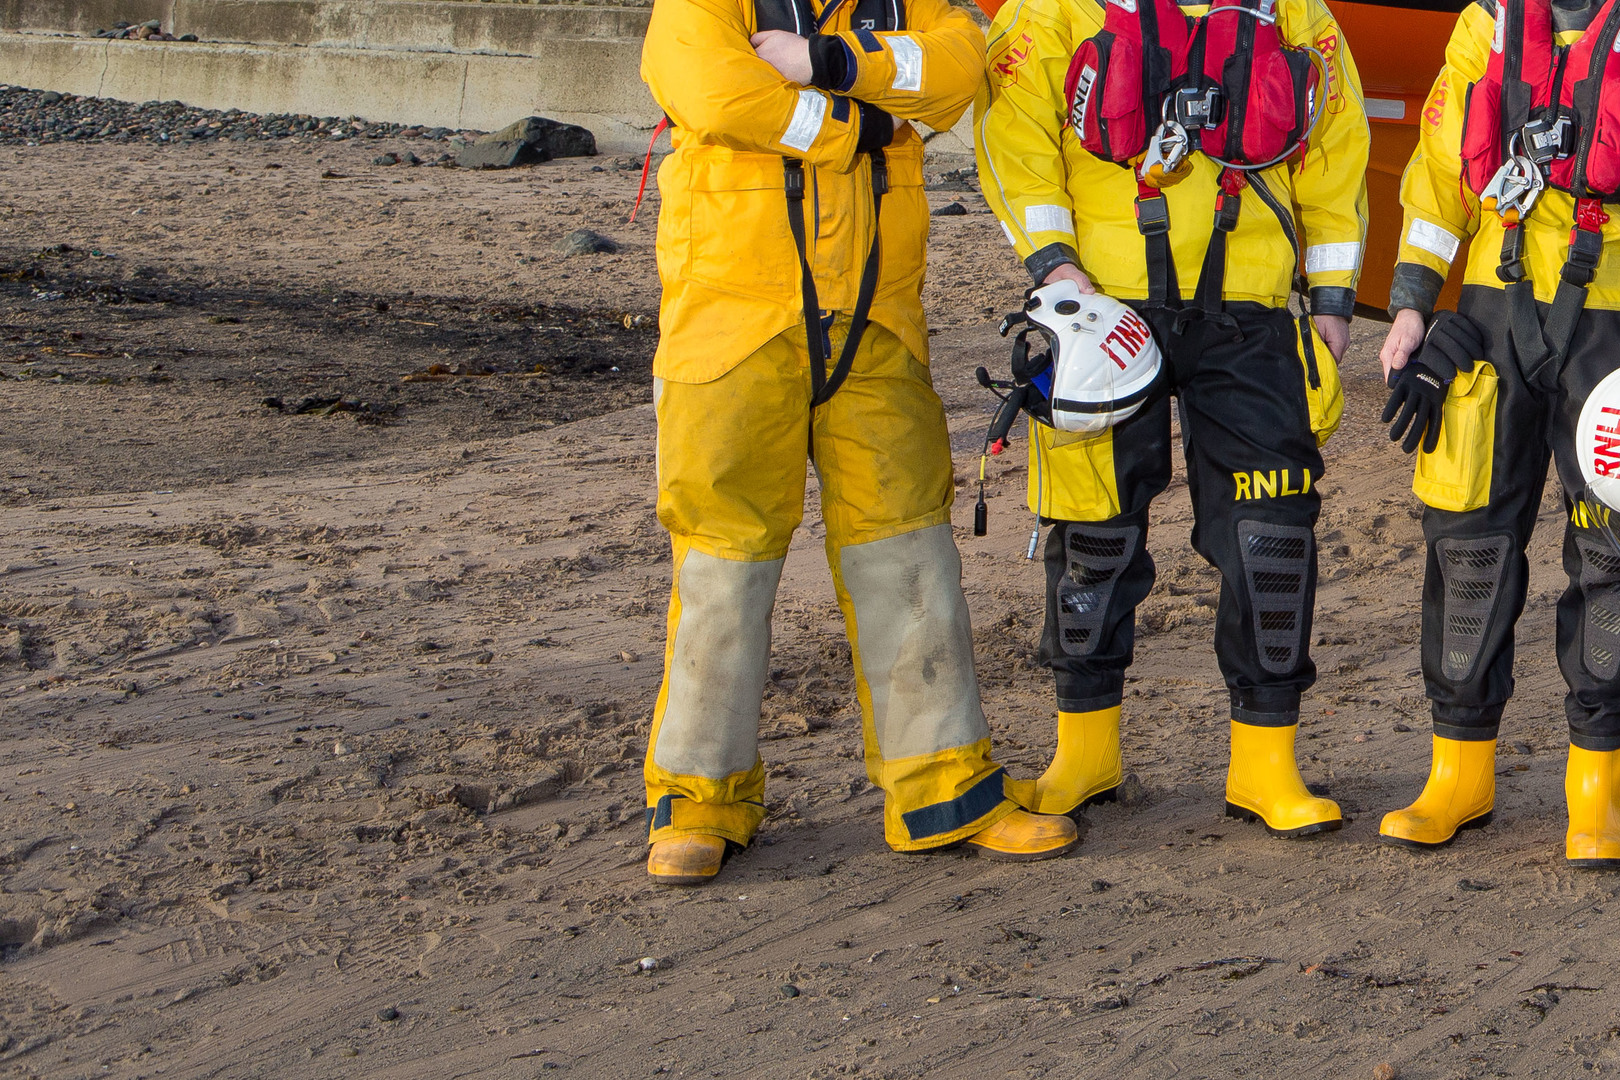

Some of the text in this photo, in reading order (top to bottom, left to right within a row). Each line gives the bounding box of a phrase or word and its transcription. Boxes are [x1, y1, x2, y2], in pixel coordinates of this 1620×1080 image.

[1072, 74, 1092, 131] RNLI
[1099, 310, 1151, 371] RNLI
[1233, 468, 1311, 501] RNLI
